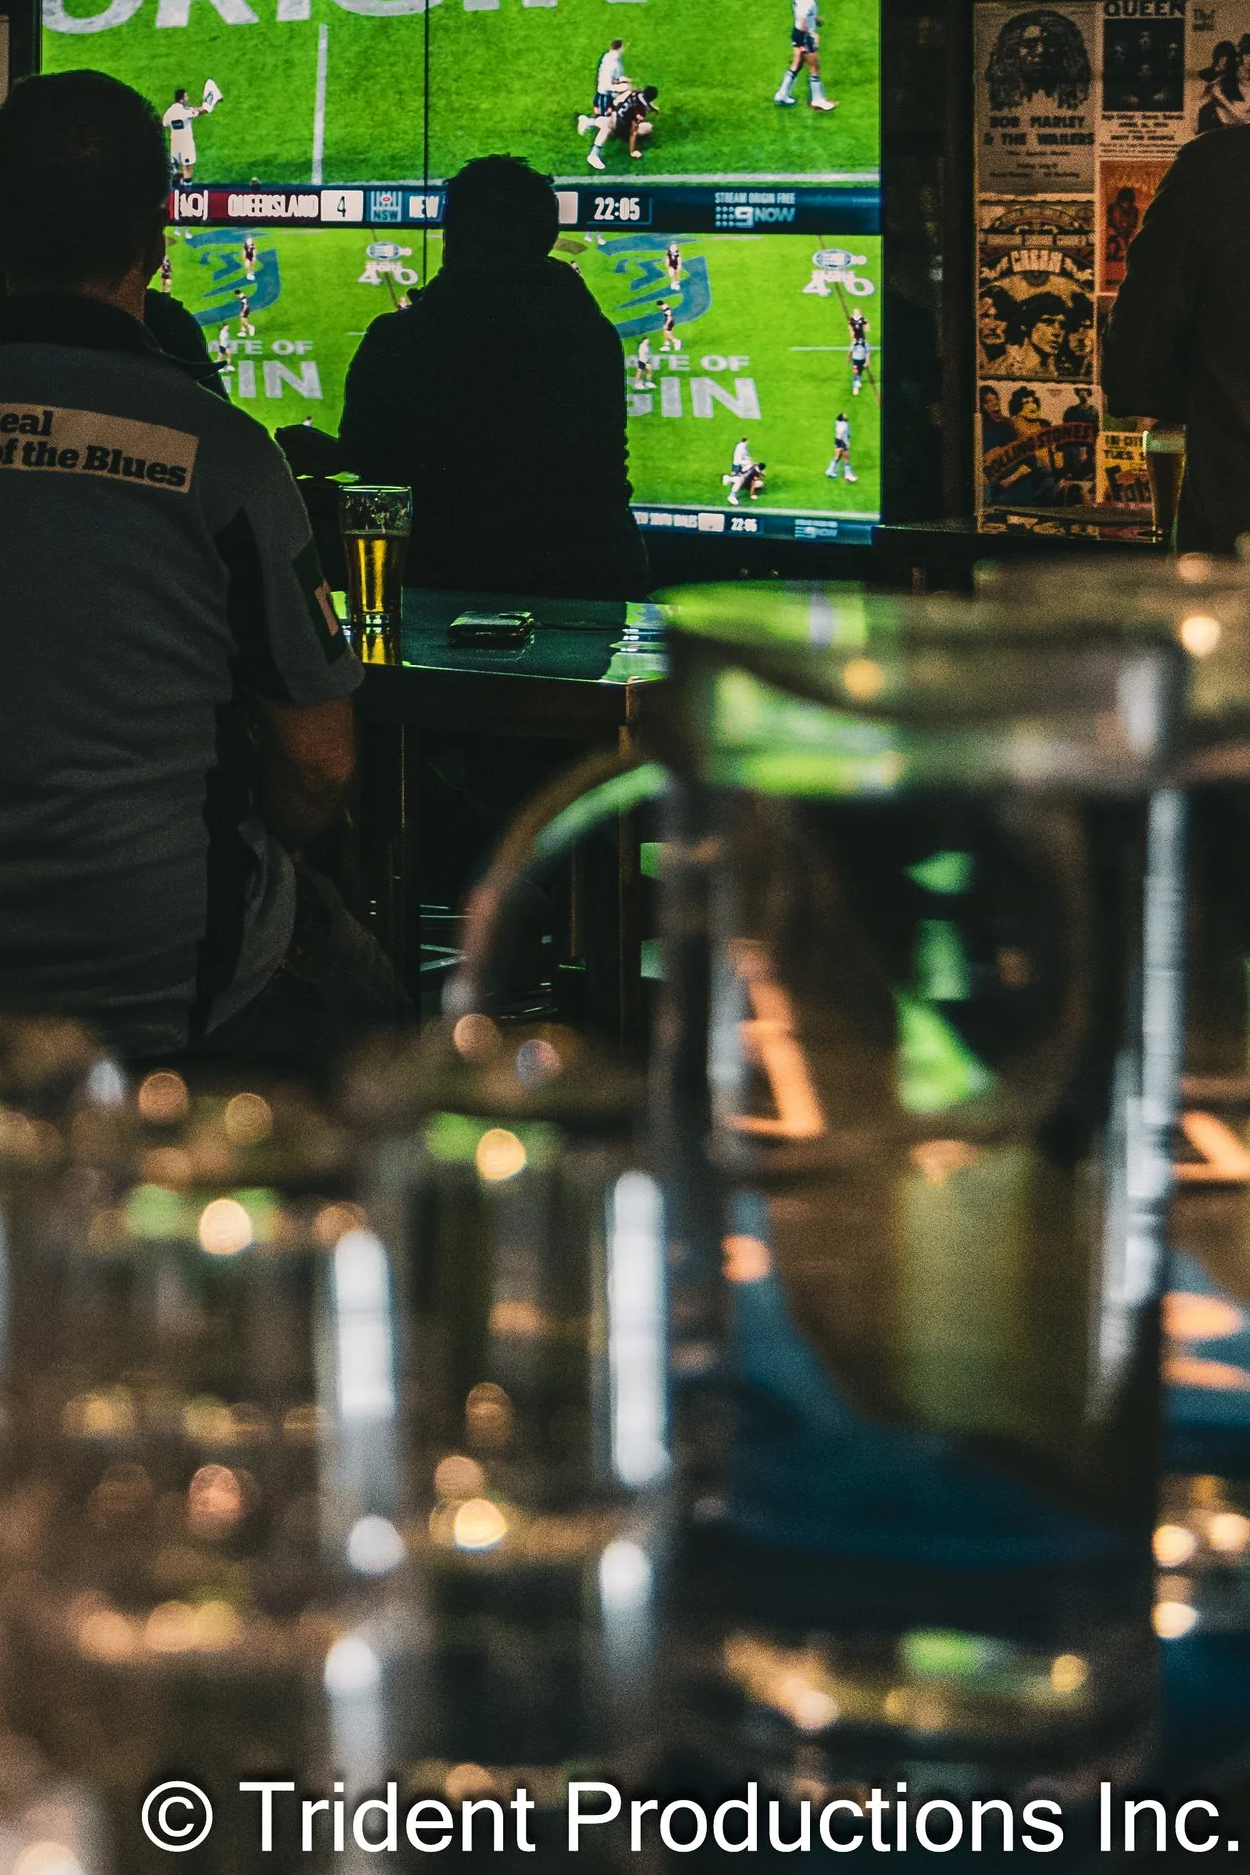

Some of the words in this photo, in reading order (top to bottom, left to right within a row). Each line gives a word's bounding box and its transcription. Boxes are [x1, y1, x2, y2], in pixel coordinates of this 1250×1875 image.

[1104, 0, 1185, 17] QUEEN
[990, 116, 1020, 129] BOB
[1030, 115, 1085, 129] MARLEY
[1001, 132, 1026, 146] THE
[1038, 132, 1094, 146] WAILERS
[227, 194, 319, 217] QUEENSLAND
[336, 196, 347, 218] 4
[715, 192, 747, 204] STREAM
[749, 192, 775, 204] ORIGIN
[777, 192, 796, 204] FREE
[373, 210, 398, 221] NSW
[594, 197, 640, 220] 22:05
[272, 340, 313, 355] OF
[701, 355, 750, 371] OF
[983, 435, 1035, 479] ROLLING
[1036, 423, 1091, 448] STONES
[21, 441, 80, 470] the
[81, 444, 188, 487] Blues
